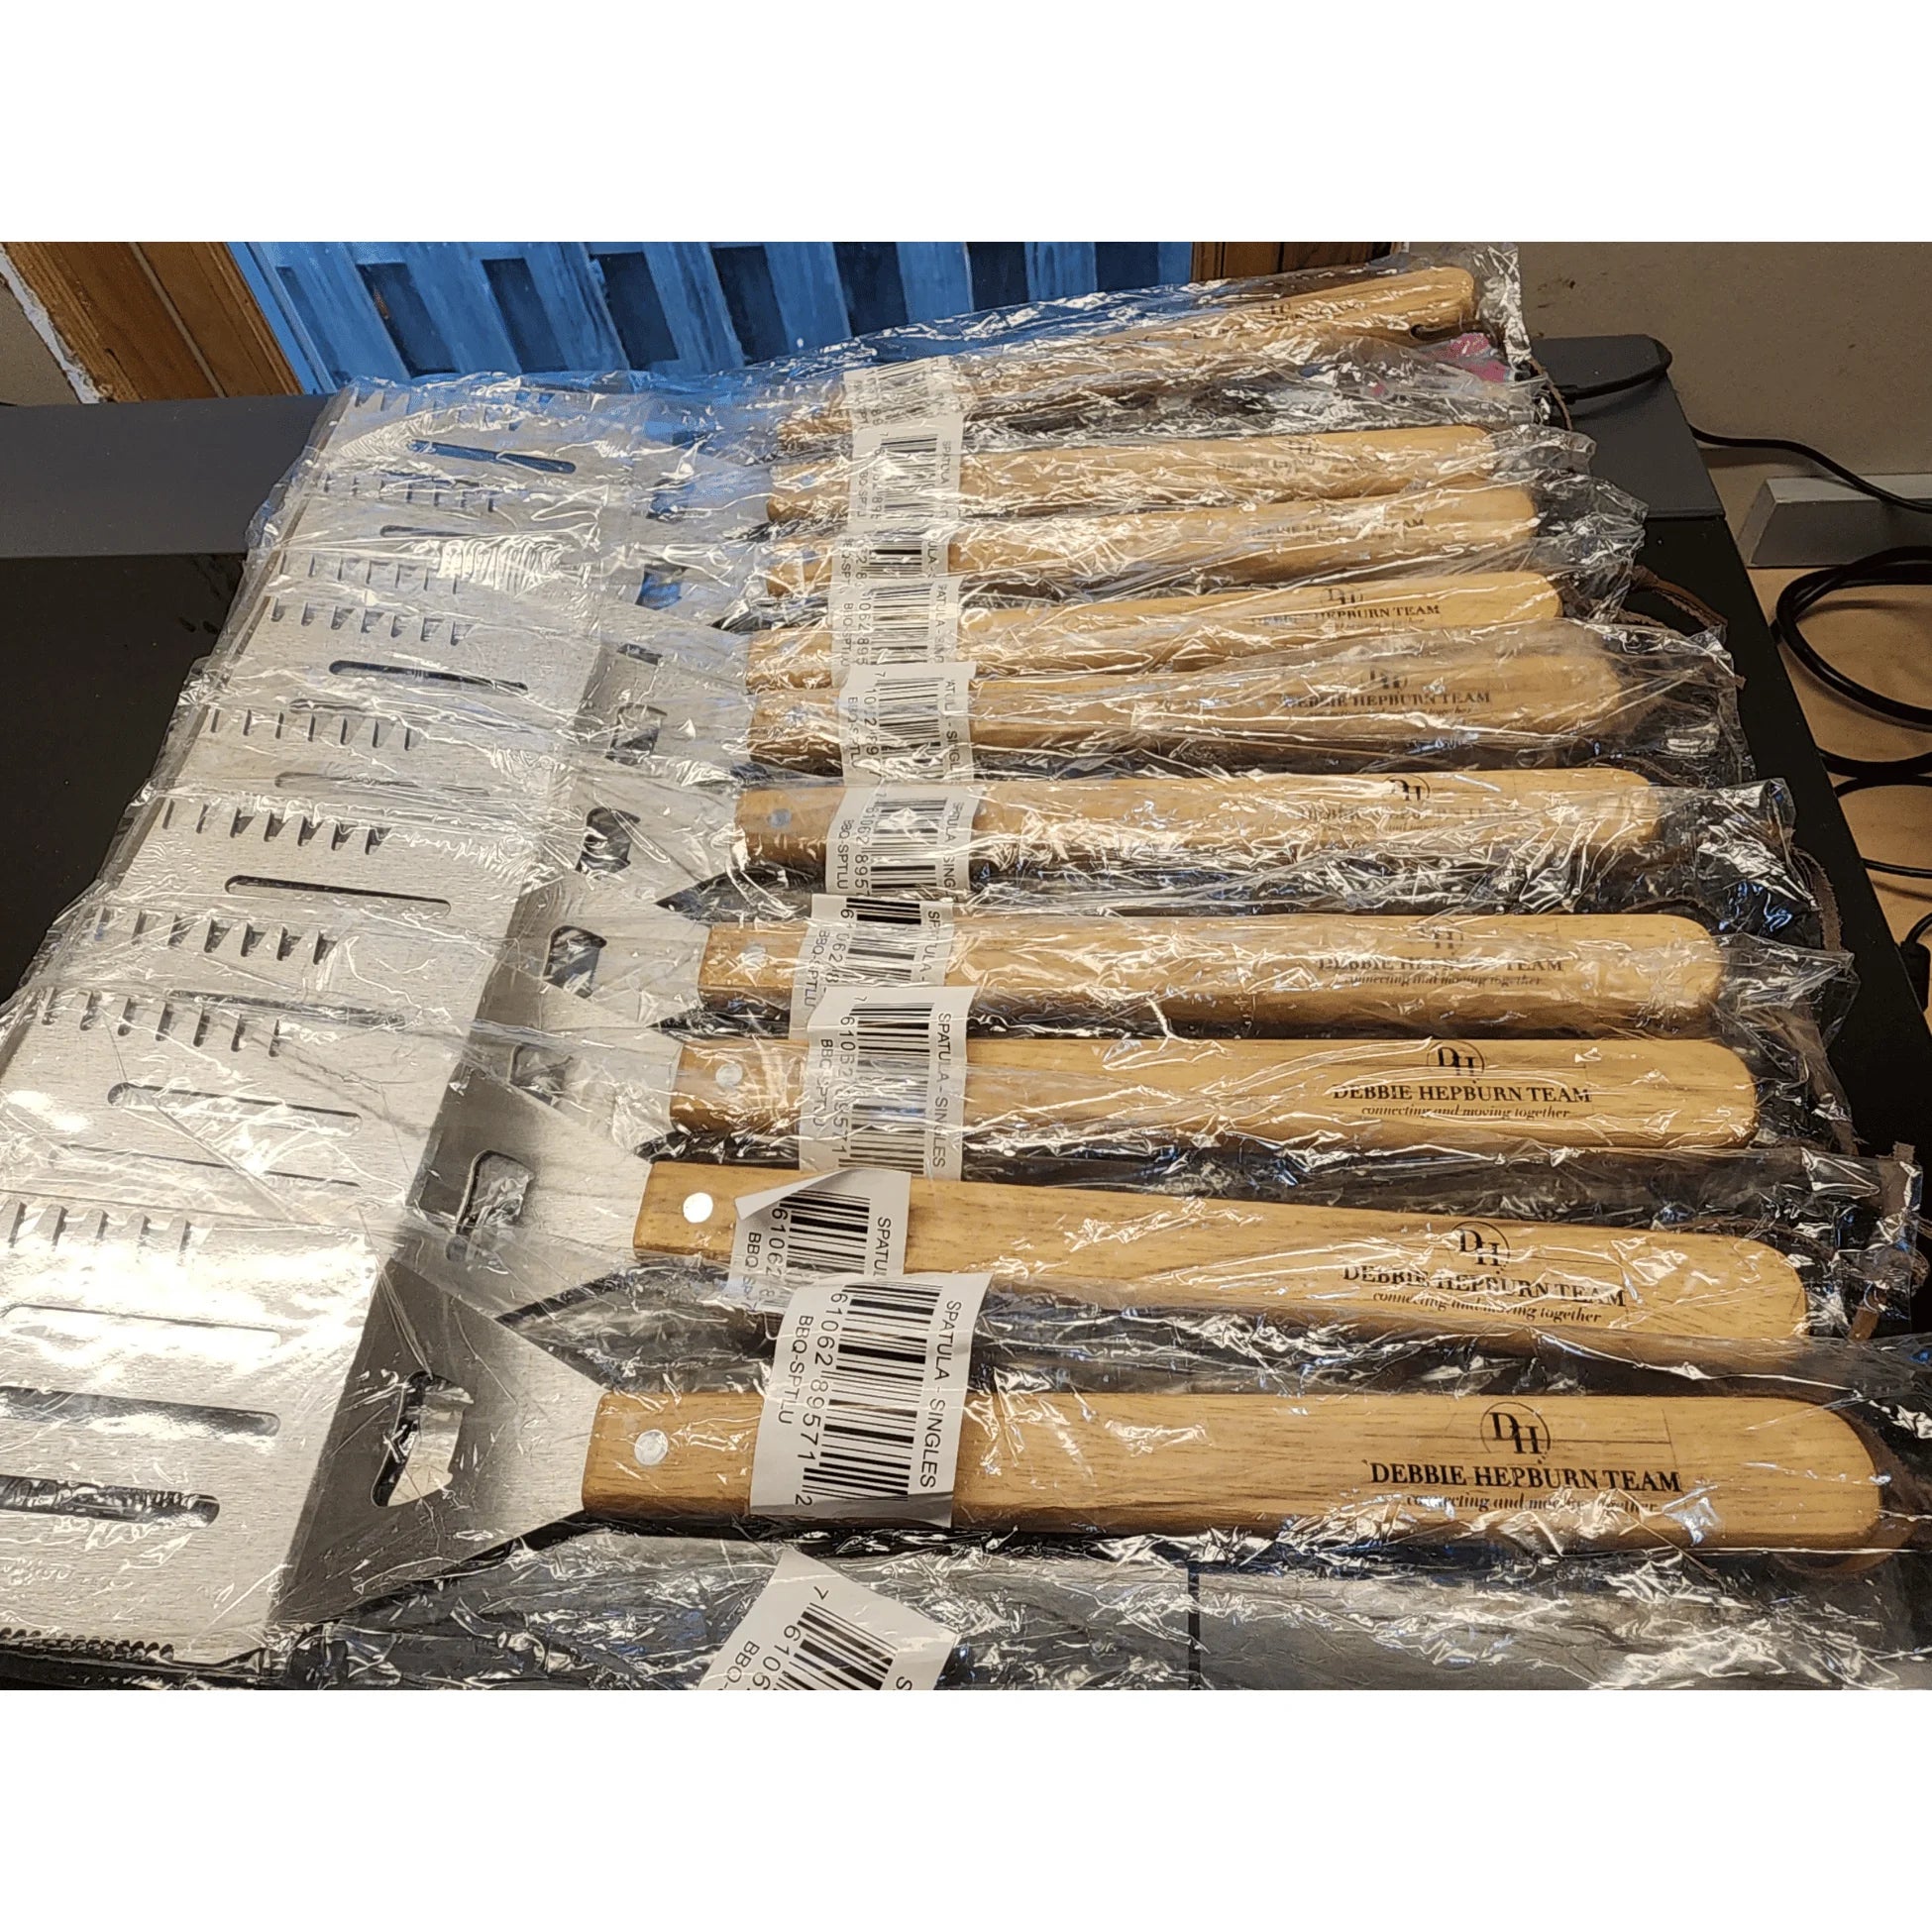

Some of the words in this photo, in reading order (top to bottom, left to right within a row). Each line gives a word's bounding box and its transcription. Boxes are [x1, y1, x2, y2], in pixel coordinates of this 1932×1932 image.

[1393, 605, 1440, 617] TEAM
[1441, 693, 1490, 704] TEAM
[854, 854, 870, 897] 8957
[936, 1013, 952, 1083] SPATULA
[1333, 1084, 1413, 1100] DEBBIE
[1419, 1085, 1523, 1102] HEPBURN
[1526, 1087, 1592, 1104] TEAM
[1461, 1105, 1511, 1120] moving
[1514, 1106, 1571, 1121] together
[873, 1216, 892, 1277] SPATUL
[814, 1291, 849, 1367] 61062
[1541, 1306, 1602, 1324] together
[934, 1299, 963, 1381] SPATULA
[777, 1314, 814, 1425] BBQ-SPTLU
[797, 1380, 830, 1462] 89571
[919, 1398, 946, 1489] SINGLES
[1370, 1462, 1468, 1486] DEBBIE
[1473, 1465, 1598, 1490] HEPBURN
[1602, 1469, 1682, 1493] TEAM
[795, 1493, 813, 1507] 2
[1493, 1493, 1525, 1510] and
[812, 1585, 830, 1601] 7
[717, 1640, 761, 1690] BBQ-
[747, 1624, 802, 1690] 6106
[895, 1675, 913, 1690] S
